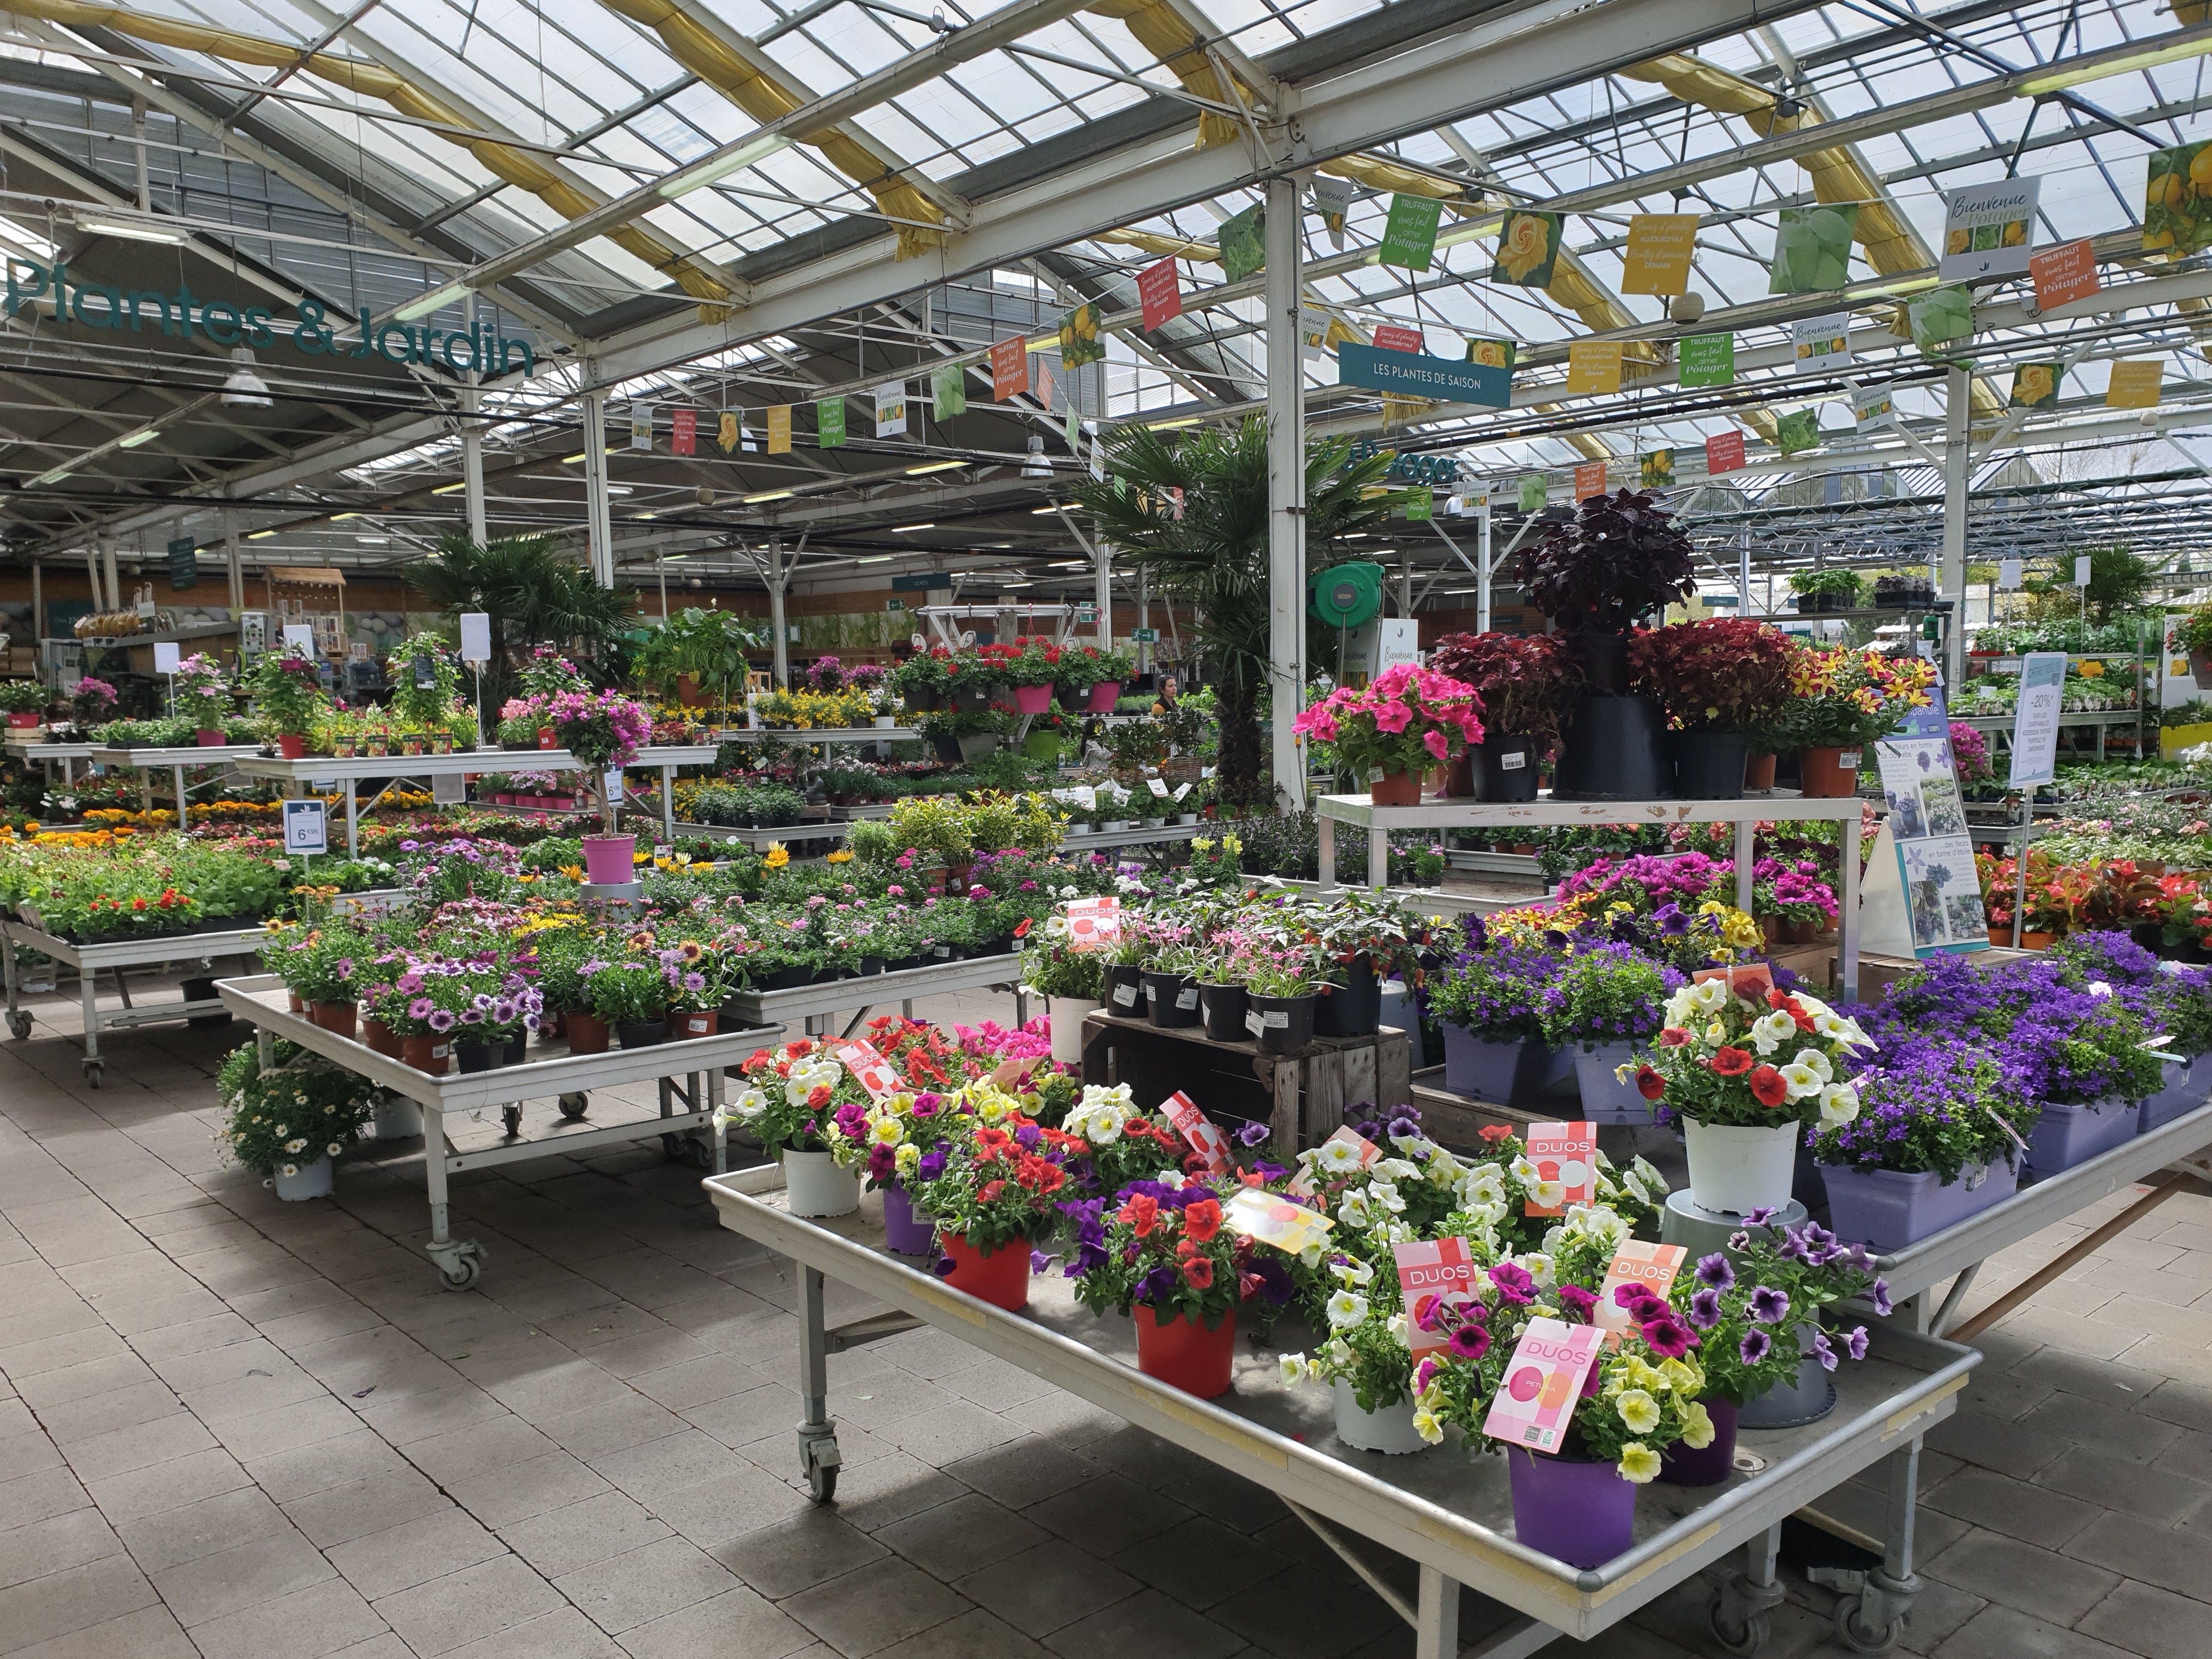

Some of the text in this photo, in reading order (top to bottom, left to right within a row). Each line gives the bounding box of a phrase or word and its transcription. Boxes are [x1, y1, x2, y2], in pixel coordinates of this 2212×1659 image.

[1401, 199, 1435, 212] TRUFFAUT
[1951, 194, 2028, 219] Bienvenue
[1403, 229, 1422, 238] aimer
[2040, 245, 2079, 264] TRUFFAUT
[7, 257, 534, 377] Plantes & Jardin
[1796, 323, 1842, 339] Bienvenue
[996, 341, 1018, 354] TRUFFAUT
[1382, 339, 1412, 348] AUJOURD'HUI
[1690, 336, 1725, 345] TRUFFAUT
[1374, 363, 1481, 390] LES PLANTES DE SAISON
[1385, 646, 1413, 663] Bienvenue
[1075, 907, 1115, 916] DUOS
[852, 1052, 879, 1069] DUOS
[1177, 1107, 1199, 1127] DUOS
[1537, 1142, 1590, 1152] DUOS
[1410, 1265, 1469, 1285] DUOS
[1617, 1262, 1670, 1280] DUOS
[1526, 1341, 1588, 1365] DUOS
[1525, 1380, 1556, 1392] PETUNIA
